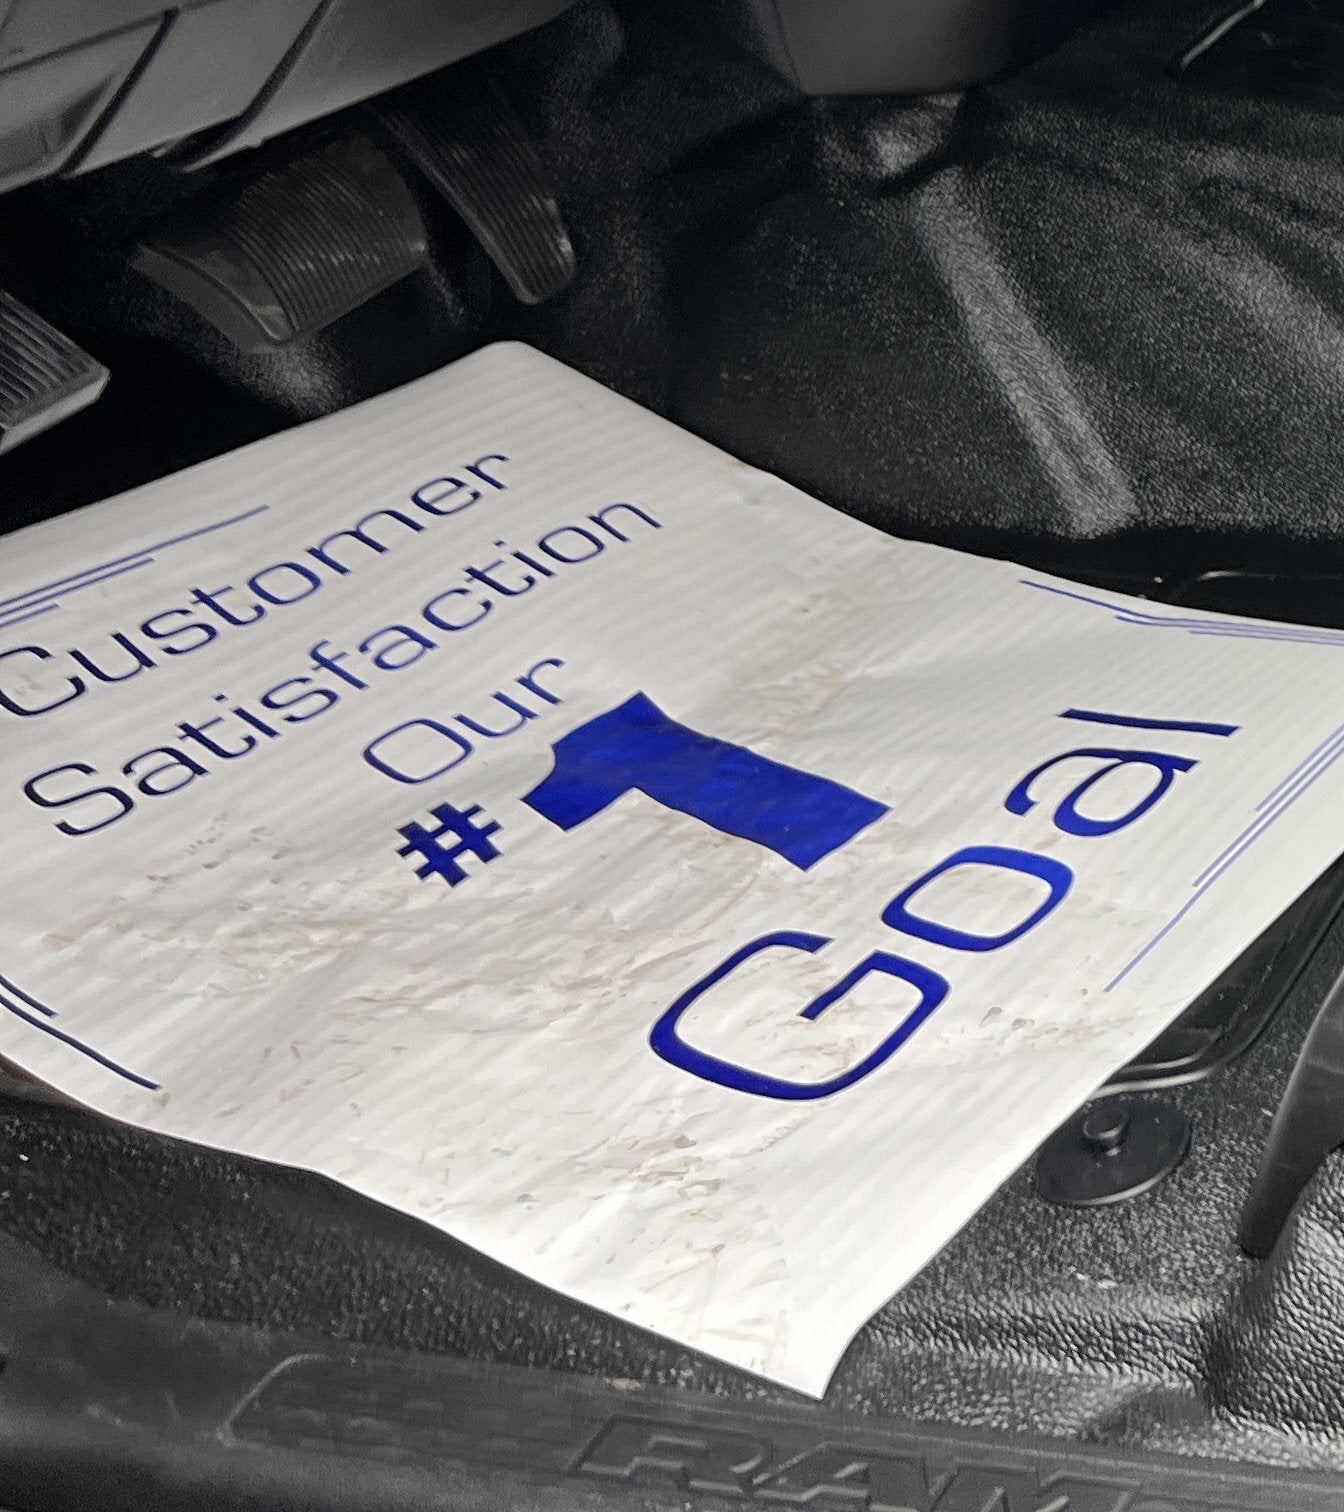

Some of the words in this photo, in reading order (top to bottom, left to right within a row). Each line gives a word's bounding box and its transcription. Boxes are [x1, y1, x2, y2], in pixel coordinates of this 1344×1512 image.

[0, 453, 511, 718] Customer
[23, 501, 663, 838] Satisfaction
[362, 655, 567, 785] Our
[649, 708, 1242, 1101] Goal
